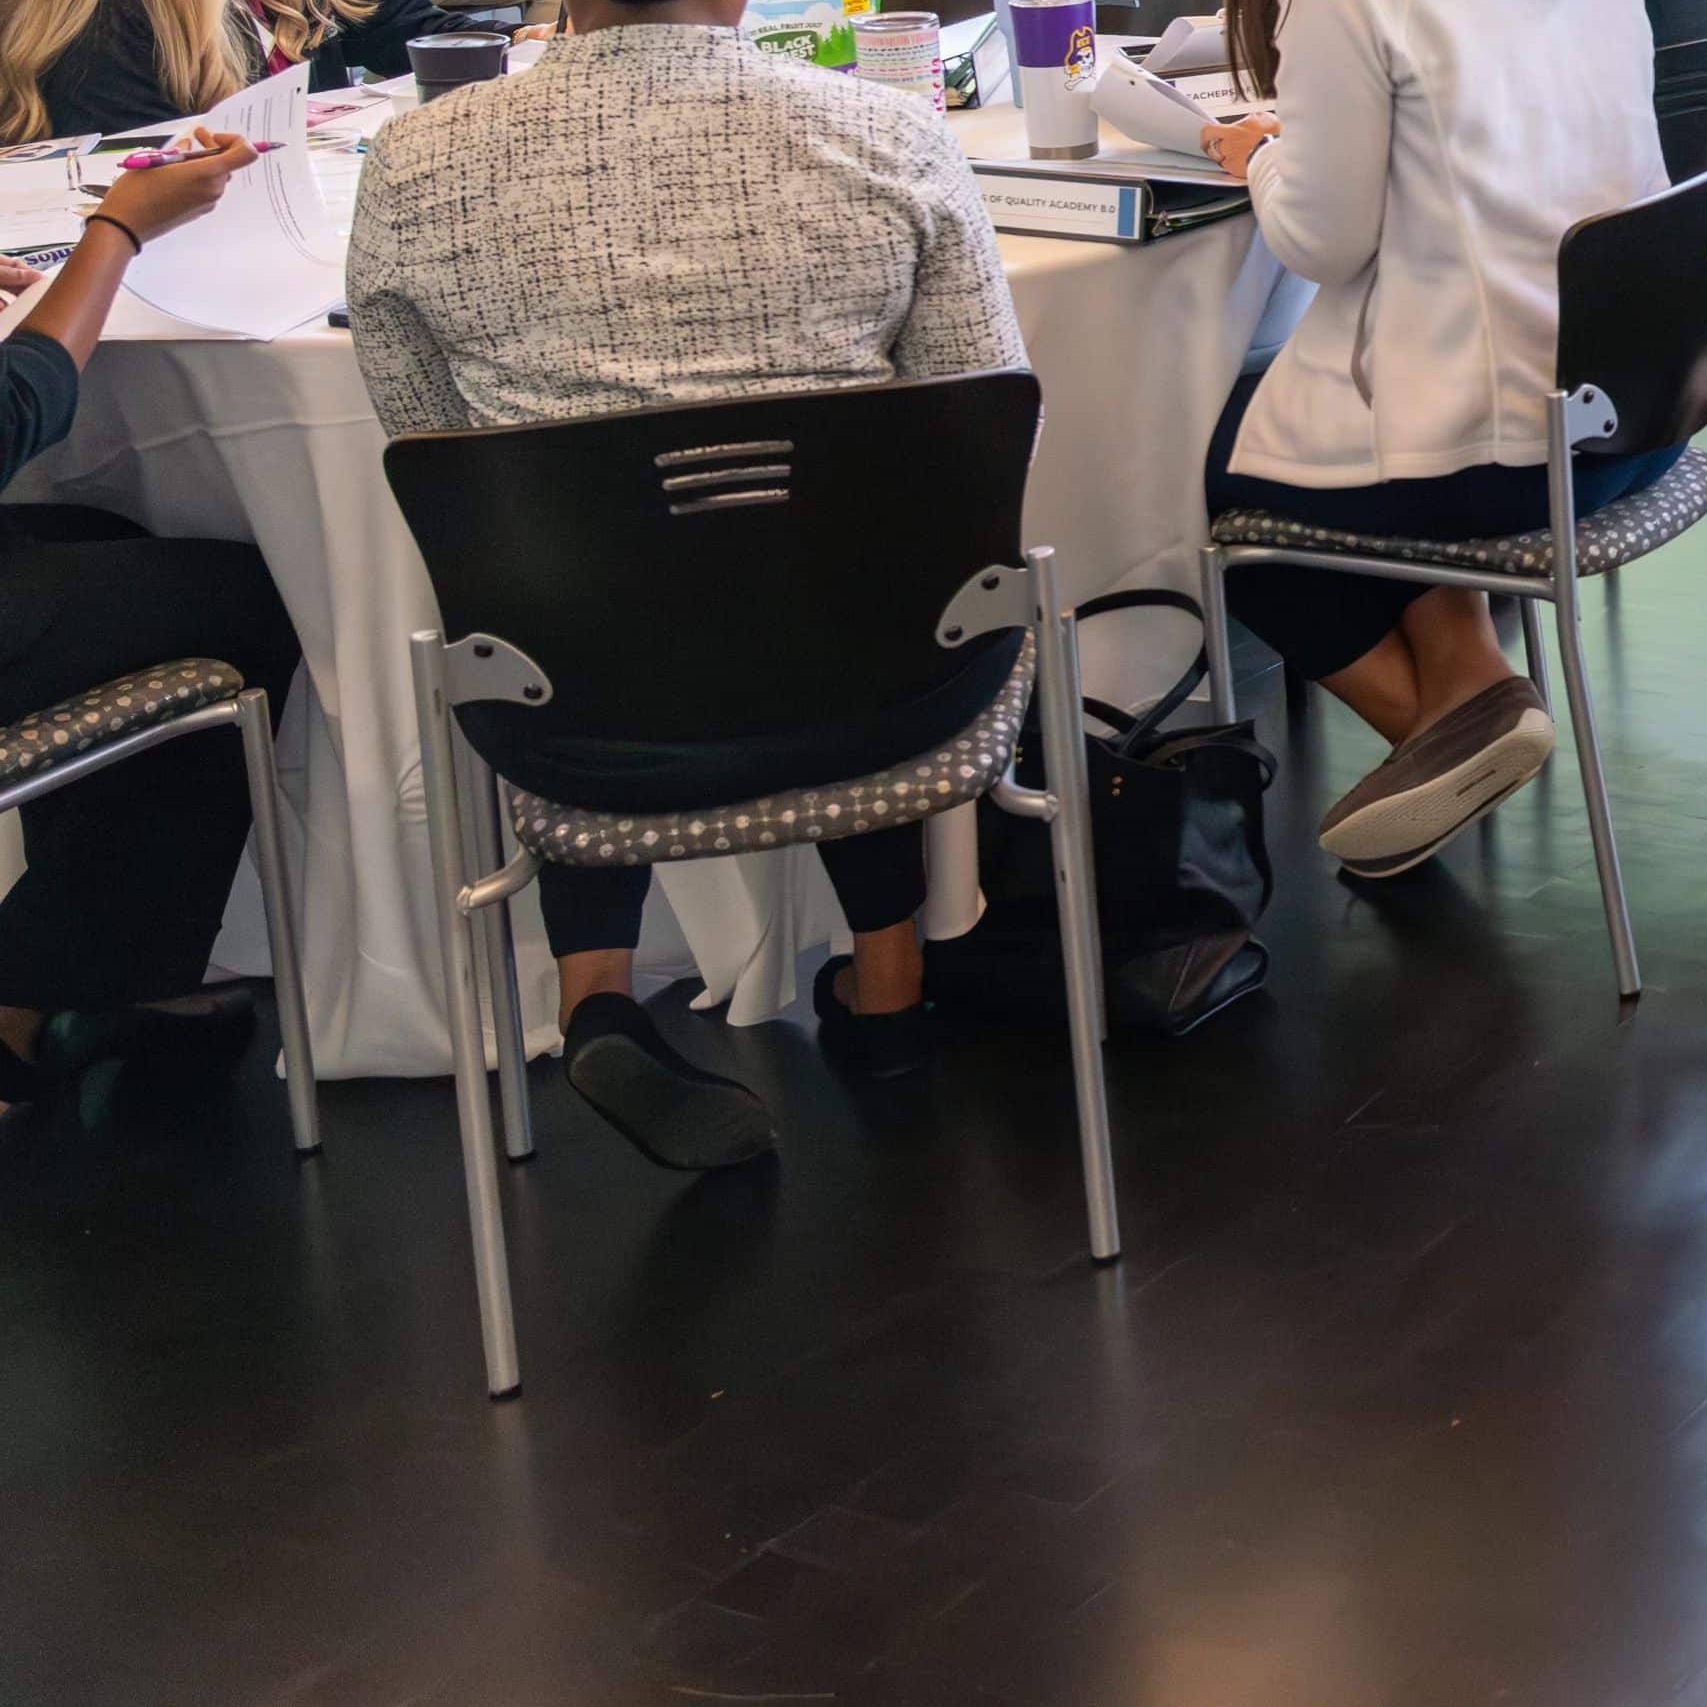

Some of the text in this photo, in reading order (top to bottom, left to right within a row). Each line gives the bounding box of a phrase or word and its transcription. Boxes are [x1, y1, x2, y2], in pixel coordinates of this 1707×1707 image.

[760, 34, 812, 53] BLACK
[989, 194, 1002, 204] OF
[1005, 195, 1047, 207] QUALITY
[1049, 199, 1098, 212] ACADEMY
